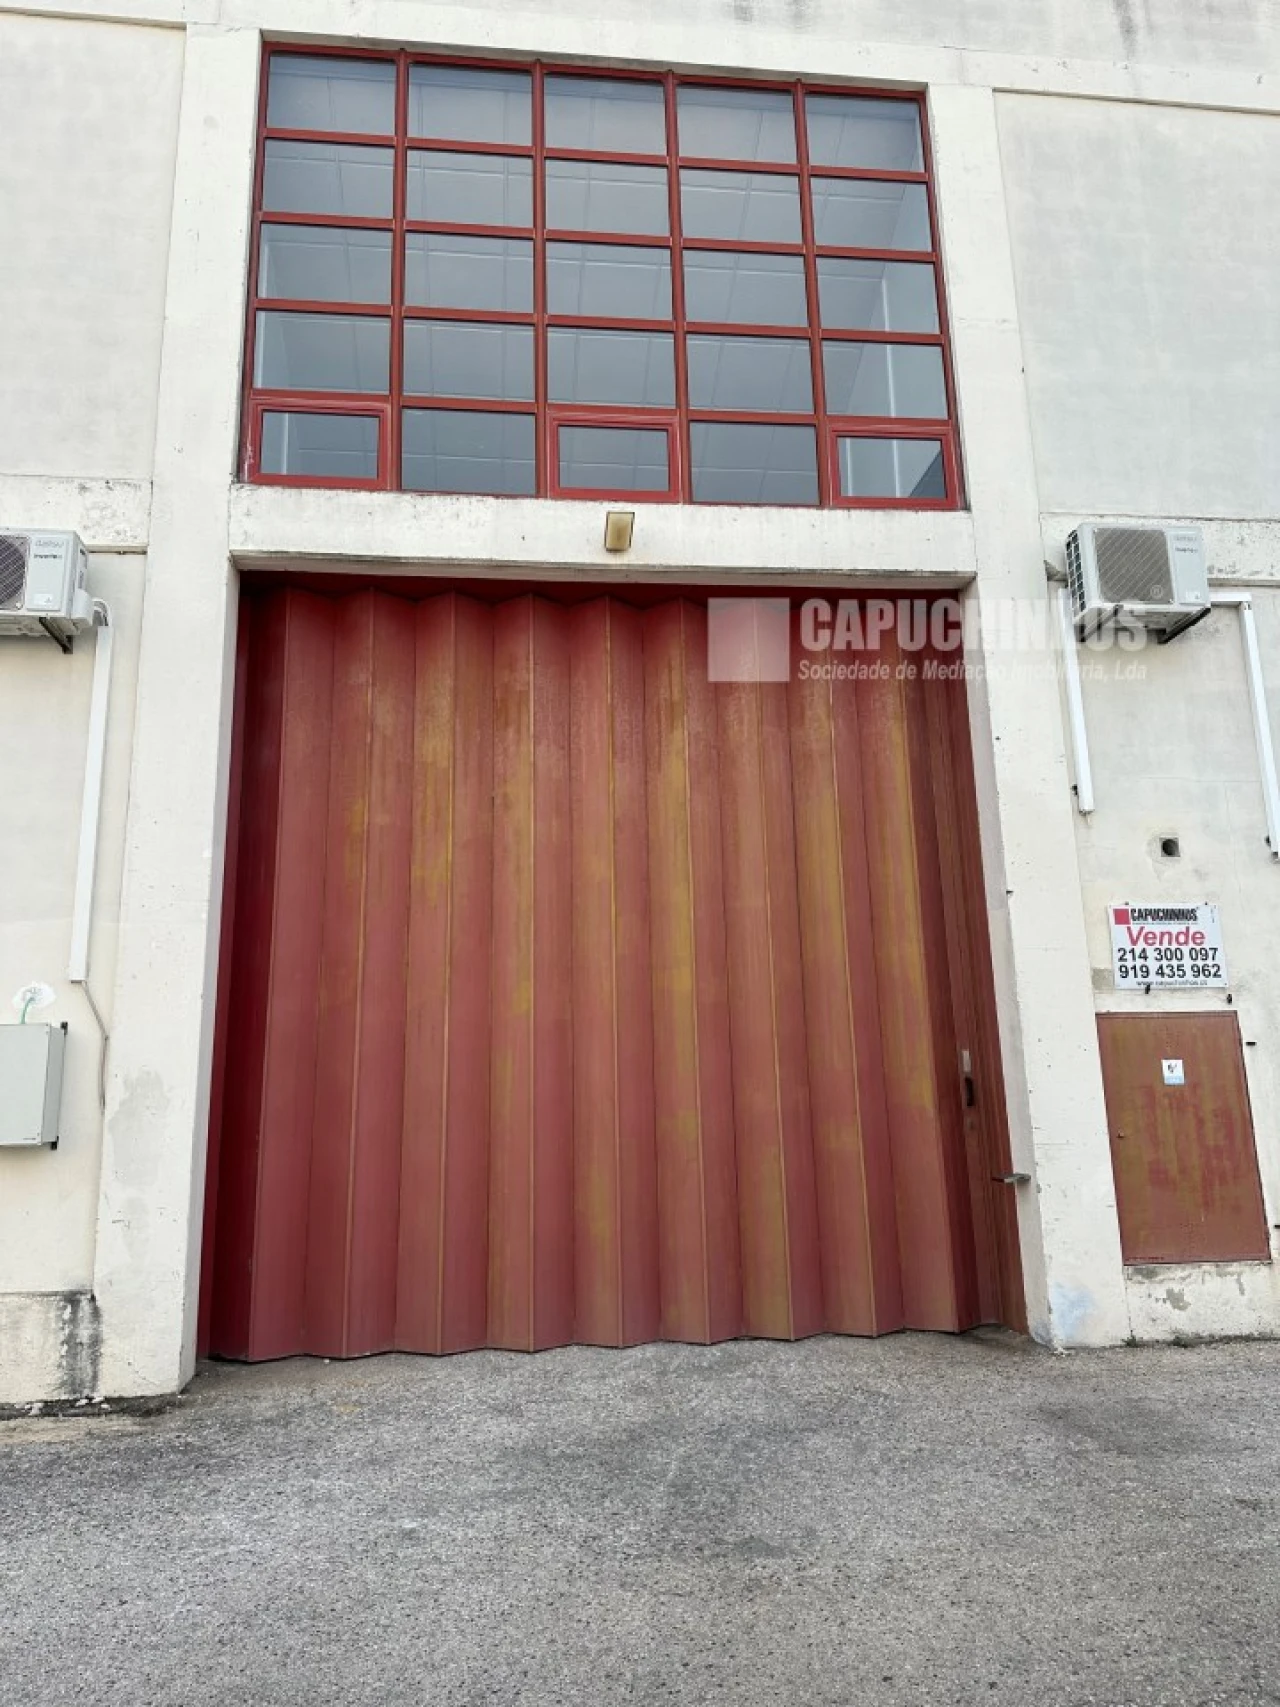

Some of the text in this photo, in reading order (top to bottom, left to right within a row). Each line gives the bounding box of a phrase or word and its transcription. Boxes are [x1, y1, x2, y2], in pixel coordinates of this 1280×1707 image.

[1126, 926, 1206, 946] Vende
[1117, 947, 1219, 962] 214 300 097
[1118, 963, 1222, 979] 919 435 962
